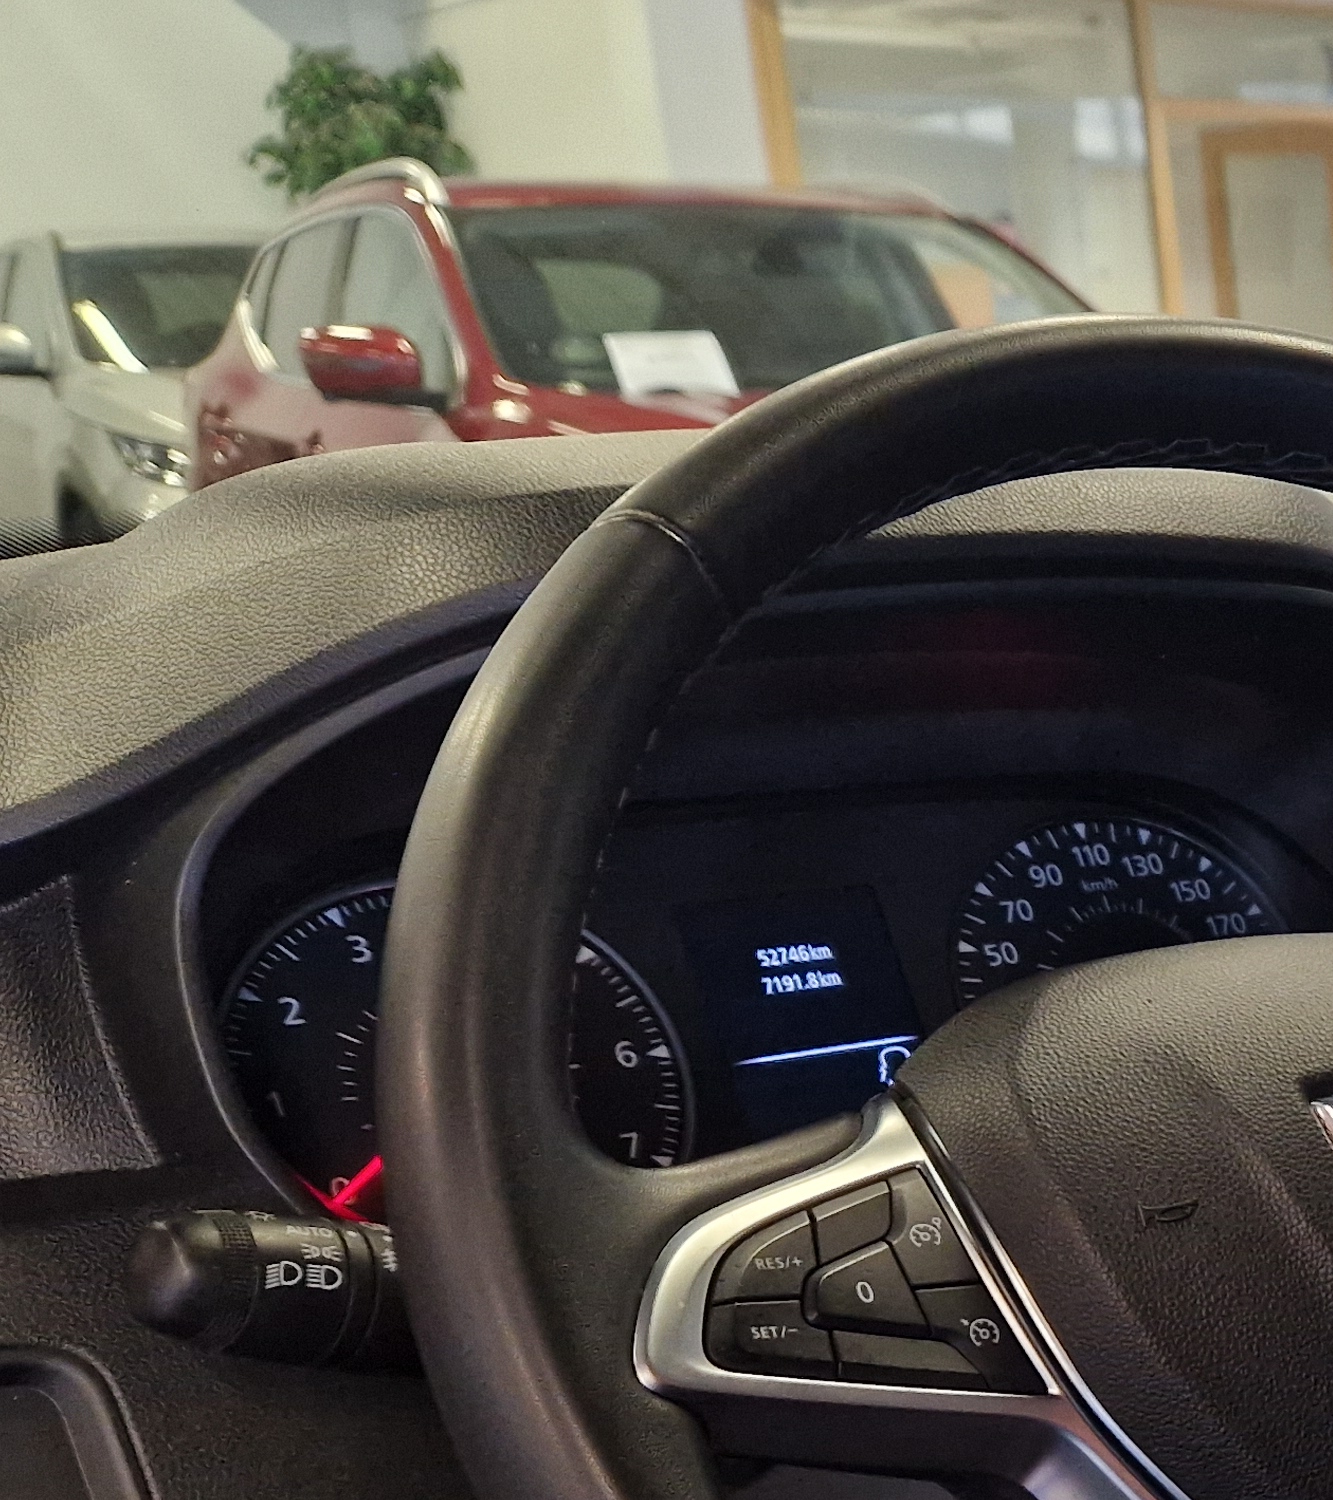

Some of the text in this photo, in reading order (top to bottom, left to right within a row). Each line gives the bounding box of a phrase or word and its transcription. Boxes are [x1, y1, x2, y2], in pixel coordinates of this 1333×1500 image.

[1071, 843, 1111, 867] 110
[1121, 853, 1163, 877] 130
[1028, 863, 1063, 888] 90
[1081, 876, 1119, 892] km/h
[1169, 878, 1211, 902] 150
[999, 898, 1034, 923] 70
[1206, 912, 1247, 936] 170
[345, 934, 372, 963] 3
[983, 941, 1019, 967] 50
[277, 996, 306, 1025] 2
[614, 1040, 639, 1068] 6
[619, 1131, 640, 1159] 7
[286, 1225, 333, 1238] AUTO
[755, 1256, 803, 1270] RES/+
[855, 1281, 875, 1303] 0
